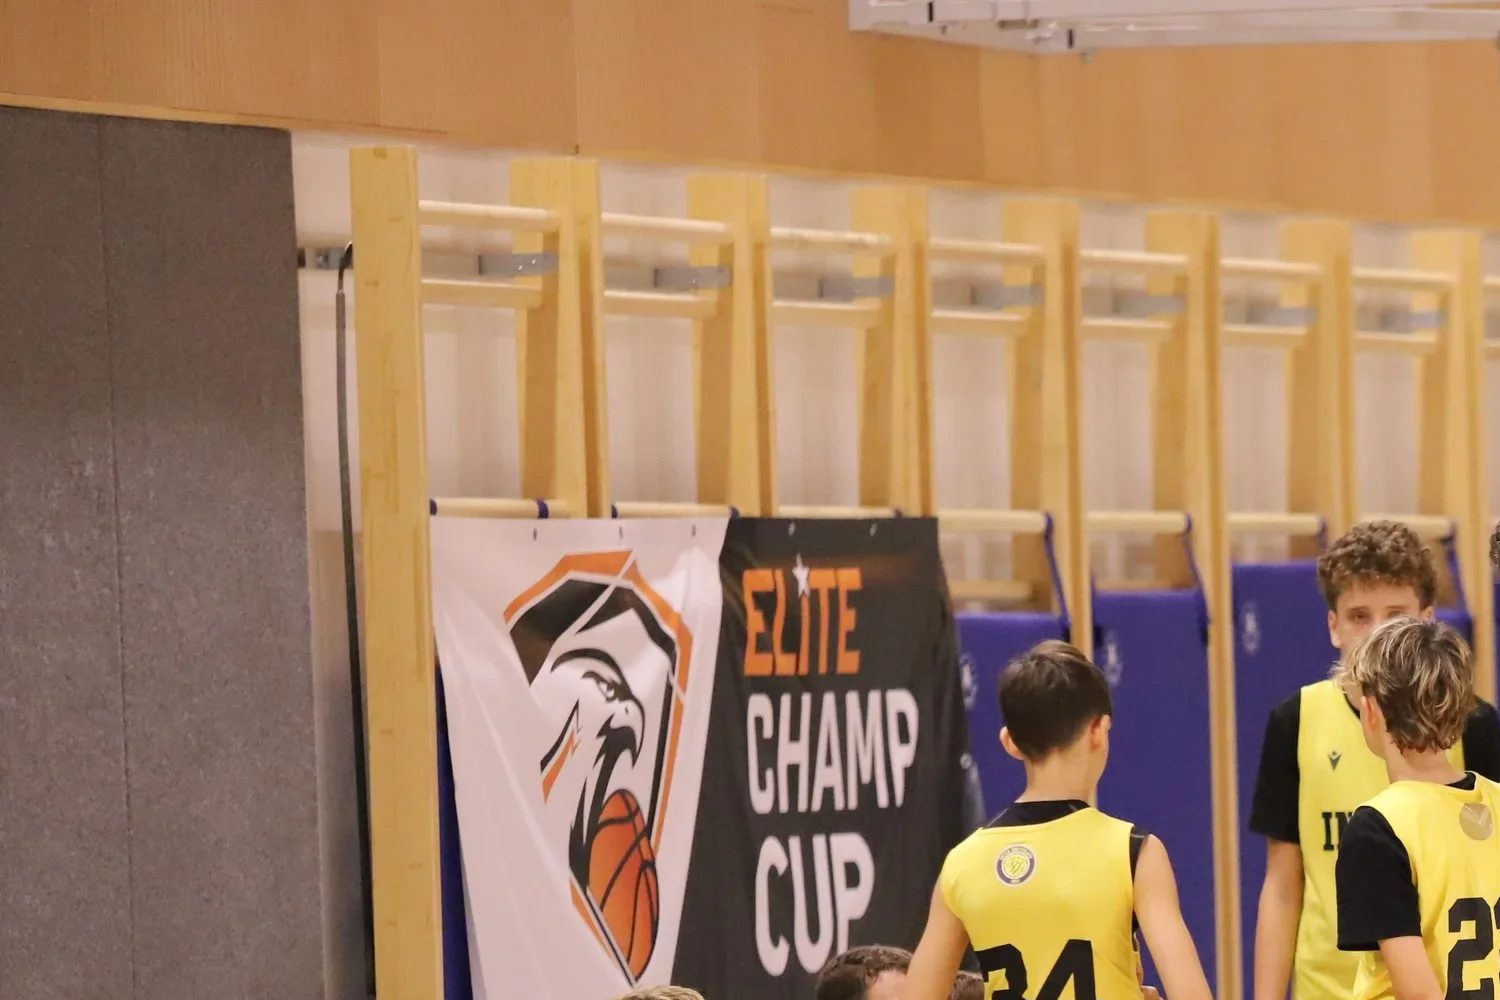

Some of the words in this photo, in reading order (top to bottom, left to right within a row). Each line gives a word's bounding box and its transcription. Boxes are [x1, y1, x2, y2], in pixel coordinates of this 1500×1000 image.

[743, 560, 863, 676] ELITE
[747, 688, 919, 814] CHAMP
[755, 832, 876, 977] CUP
